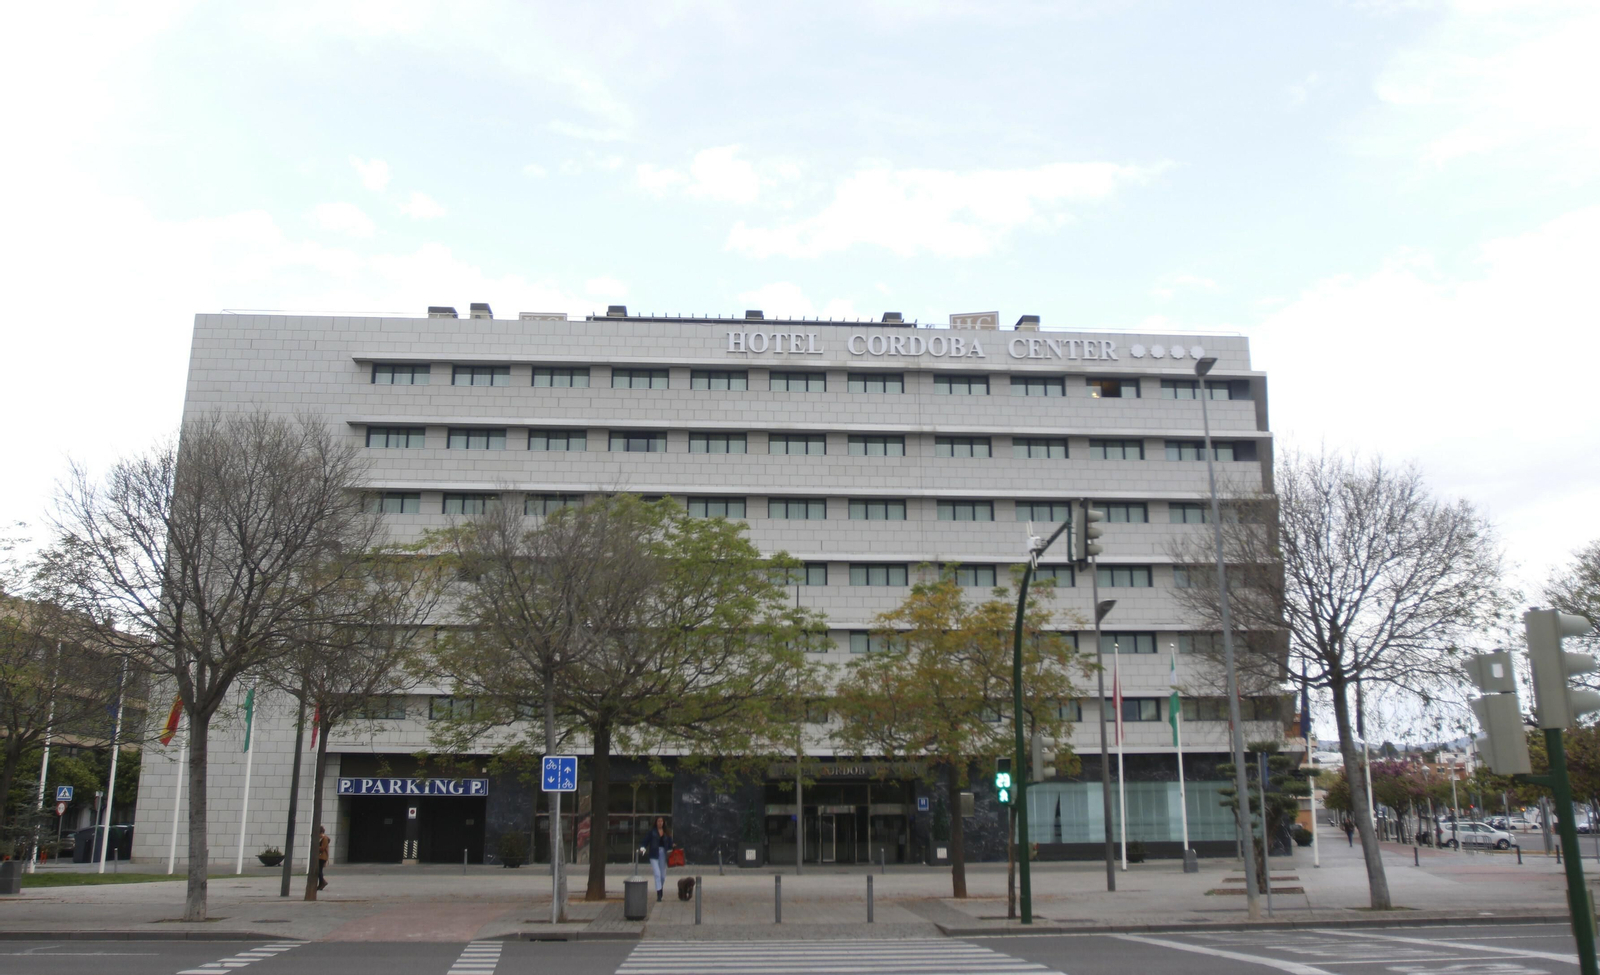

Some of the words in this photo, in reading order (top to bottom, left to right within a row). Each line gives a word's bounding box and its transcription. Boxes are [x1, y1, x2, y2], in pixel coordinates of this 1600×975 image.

[726, 332, 824, 355] HOTEL
[847, 335, 986, 358] CORDOBA
[1008, 338, 1119, 361] CENTER
[340, 780, 350, 793] P
[361, 779, 464, 794] PARKING
[471, 780, 482, 793] P
